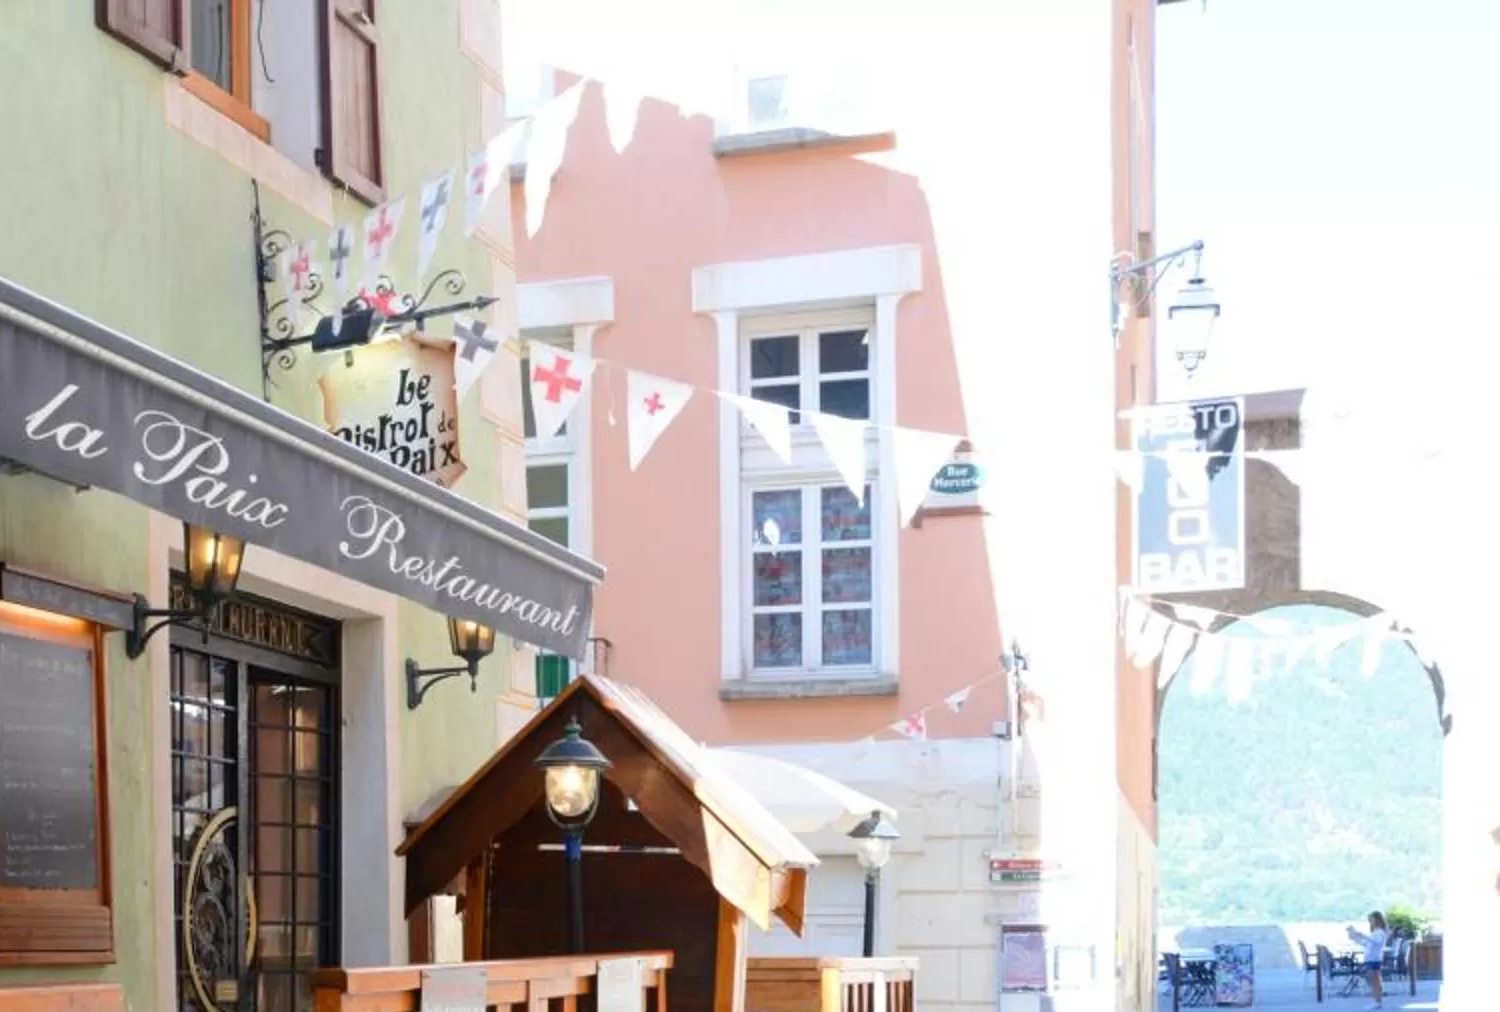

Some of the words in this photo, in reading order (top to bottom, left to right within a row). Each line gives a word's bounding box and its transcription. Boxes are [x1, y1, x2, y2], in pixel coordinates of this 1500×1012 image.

[25, 383, 109, 460] la
[132, 407, 290, 529] Paix
[339, 494, 583, 638] Restaurant
